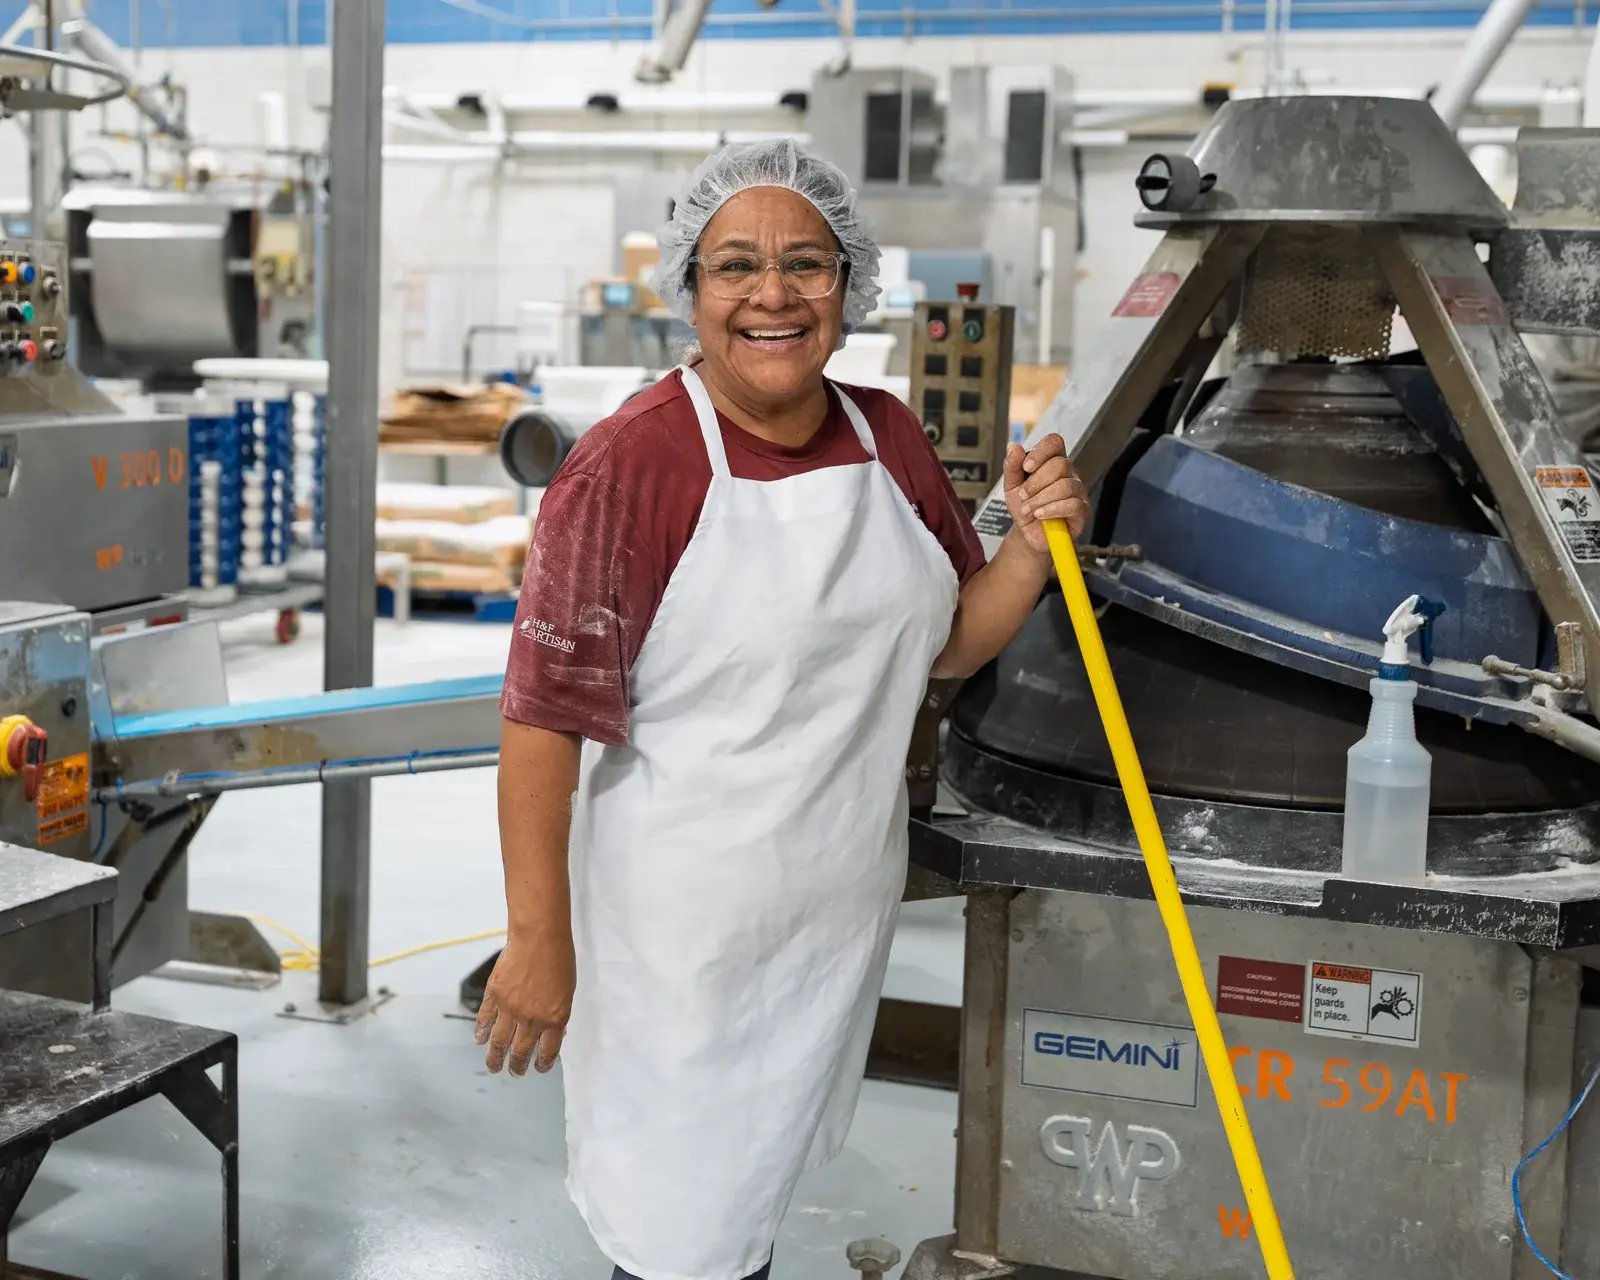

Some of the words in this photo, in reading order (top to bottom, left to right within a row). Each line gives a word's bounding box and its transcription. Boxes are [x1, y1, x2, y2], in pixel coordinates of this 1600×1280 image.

[532, 618, 555, 632] H&F
[531, 628, 576, 650] ARTISAN
[1329, 967, 1369, 982] WARNING
[1315, 983, 1338, 996] Keep
[1314, 998, 1345, 1009] guards
[1313, 1008, 1322, 1018] in
[1324, 1011, 1350, 1022] place.
[1320, 1057, 1470, 1125] 59AT
